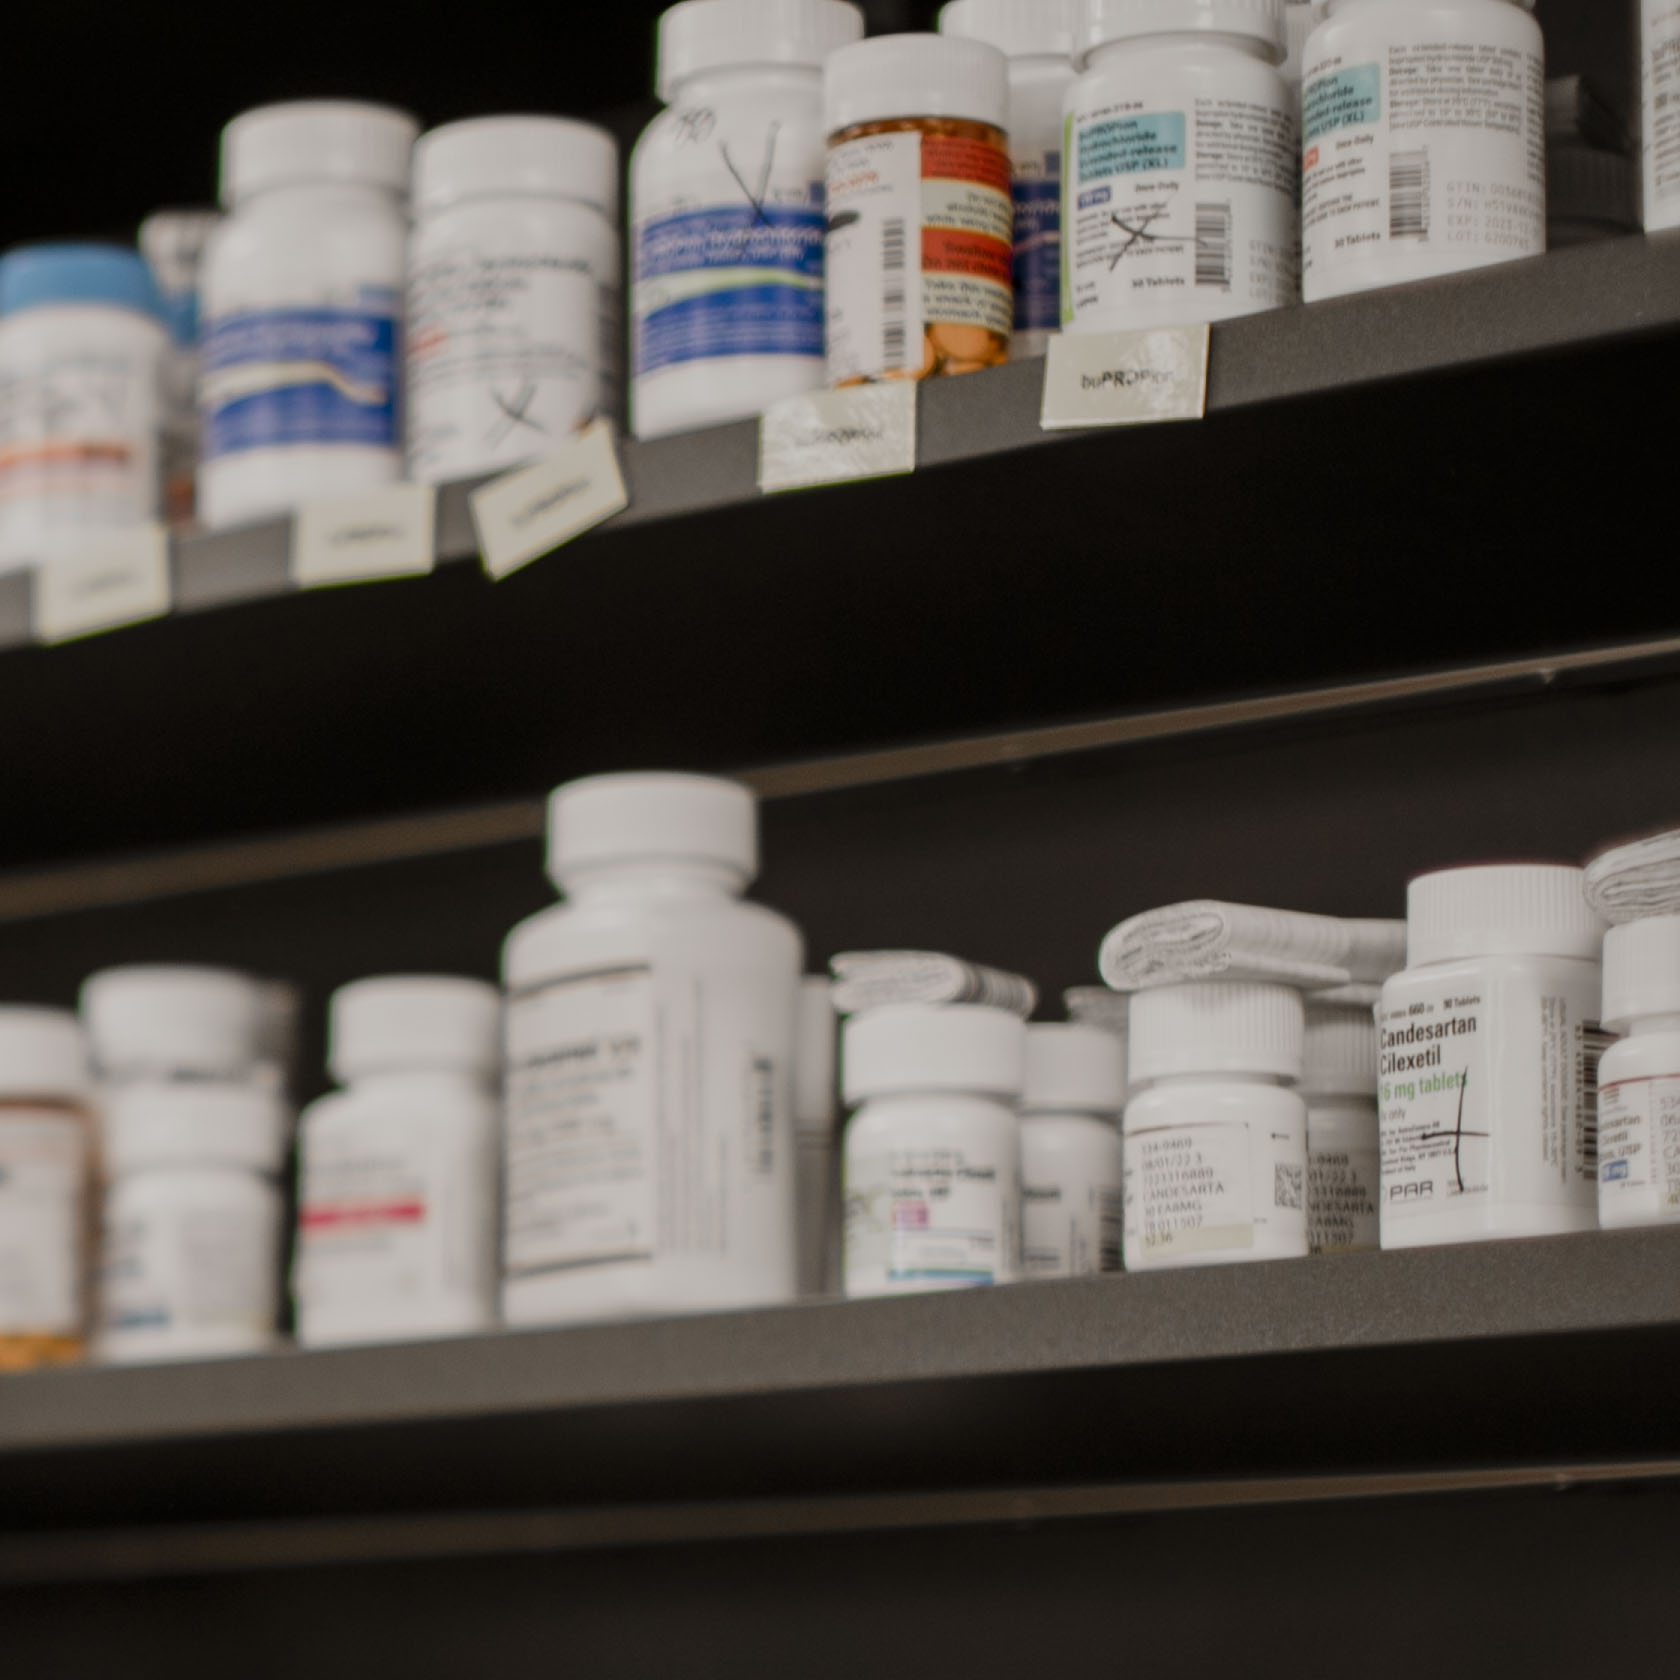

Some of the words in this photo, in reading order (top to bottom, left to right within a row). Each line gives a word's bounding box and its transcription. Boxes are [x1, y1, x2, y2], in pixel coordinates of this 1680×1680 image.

[1380, 1016, 1477, 1051] Candesartan
[1380, 1045, 1442, 1075] Cilexetil
[1394, 1081, 1415, 1101] mg
[1419, 1071, 1469, 1096] tablets
[1390, 1180, 1434, 1201] PAR
